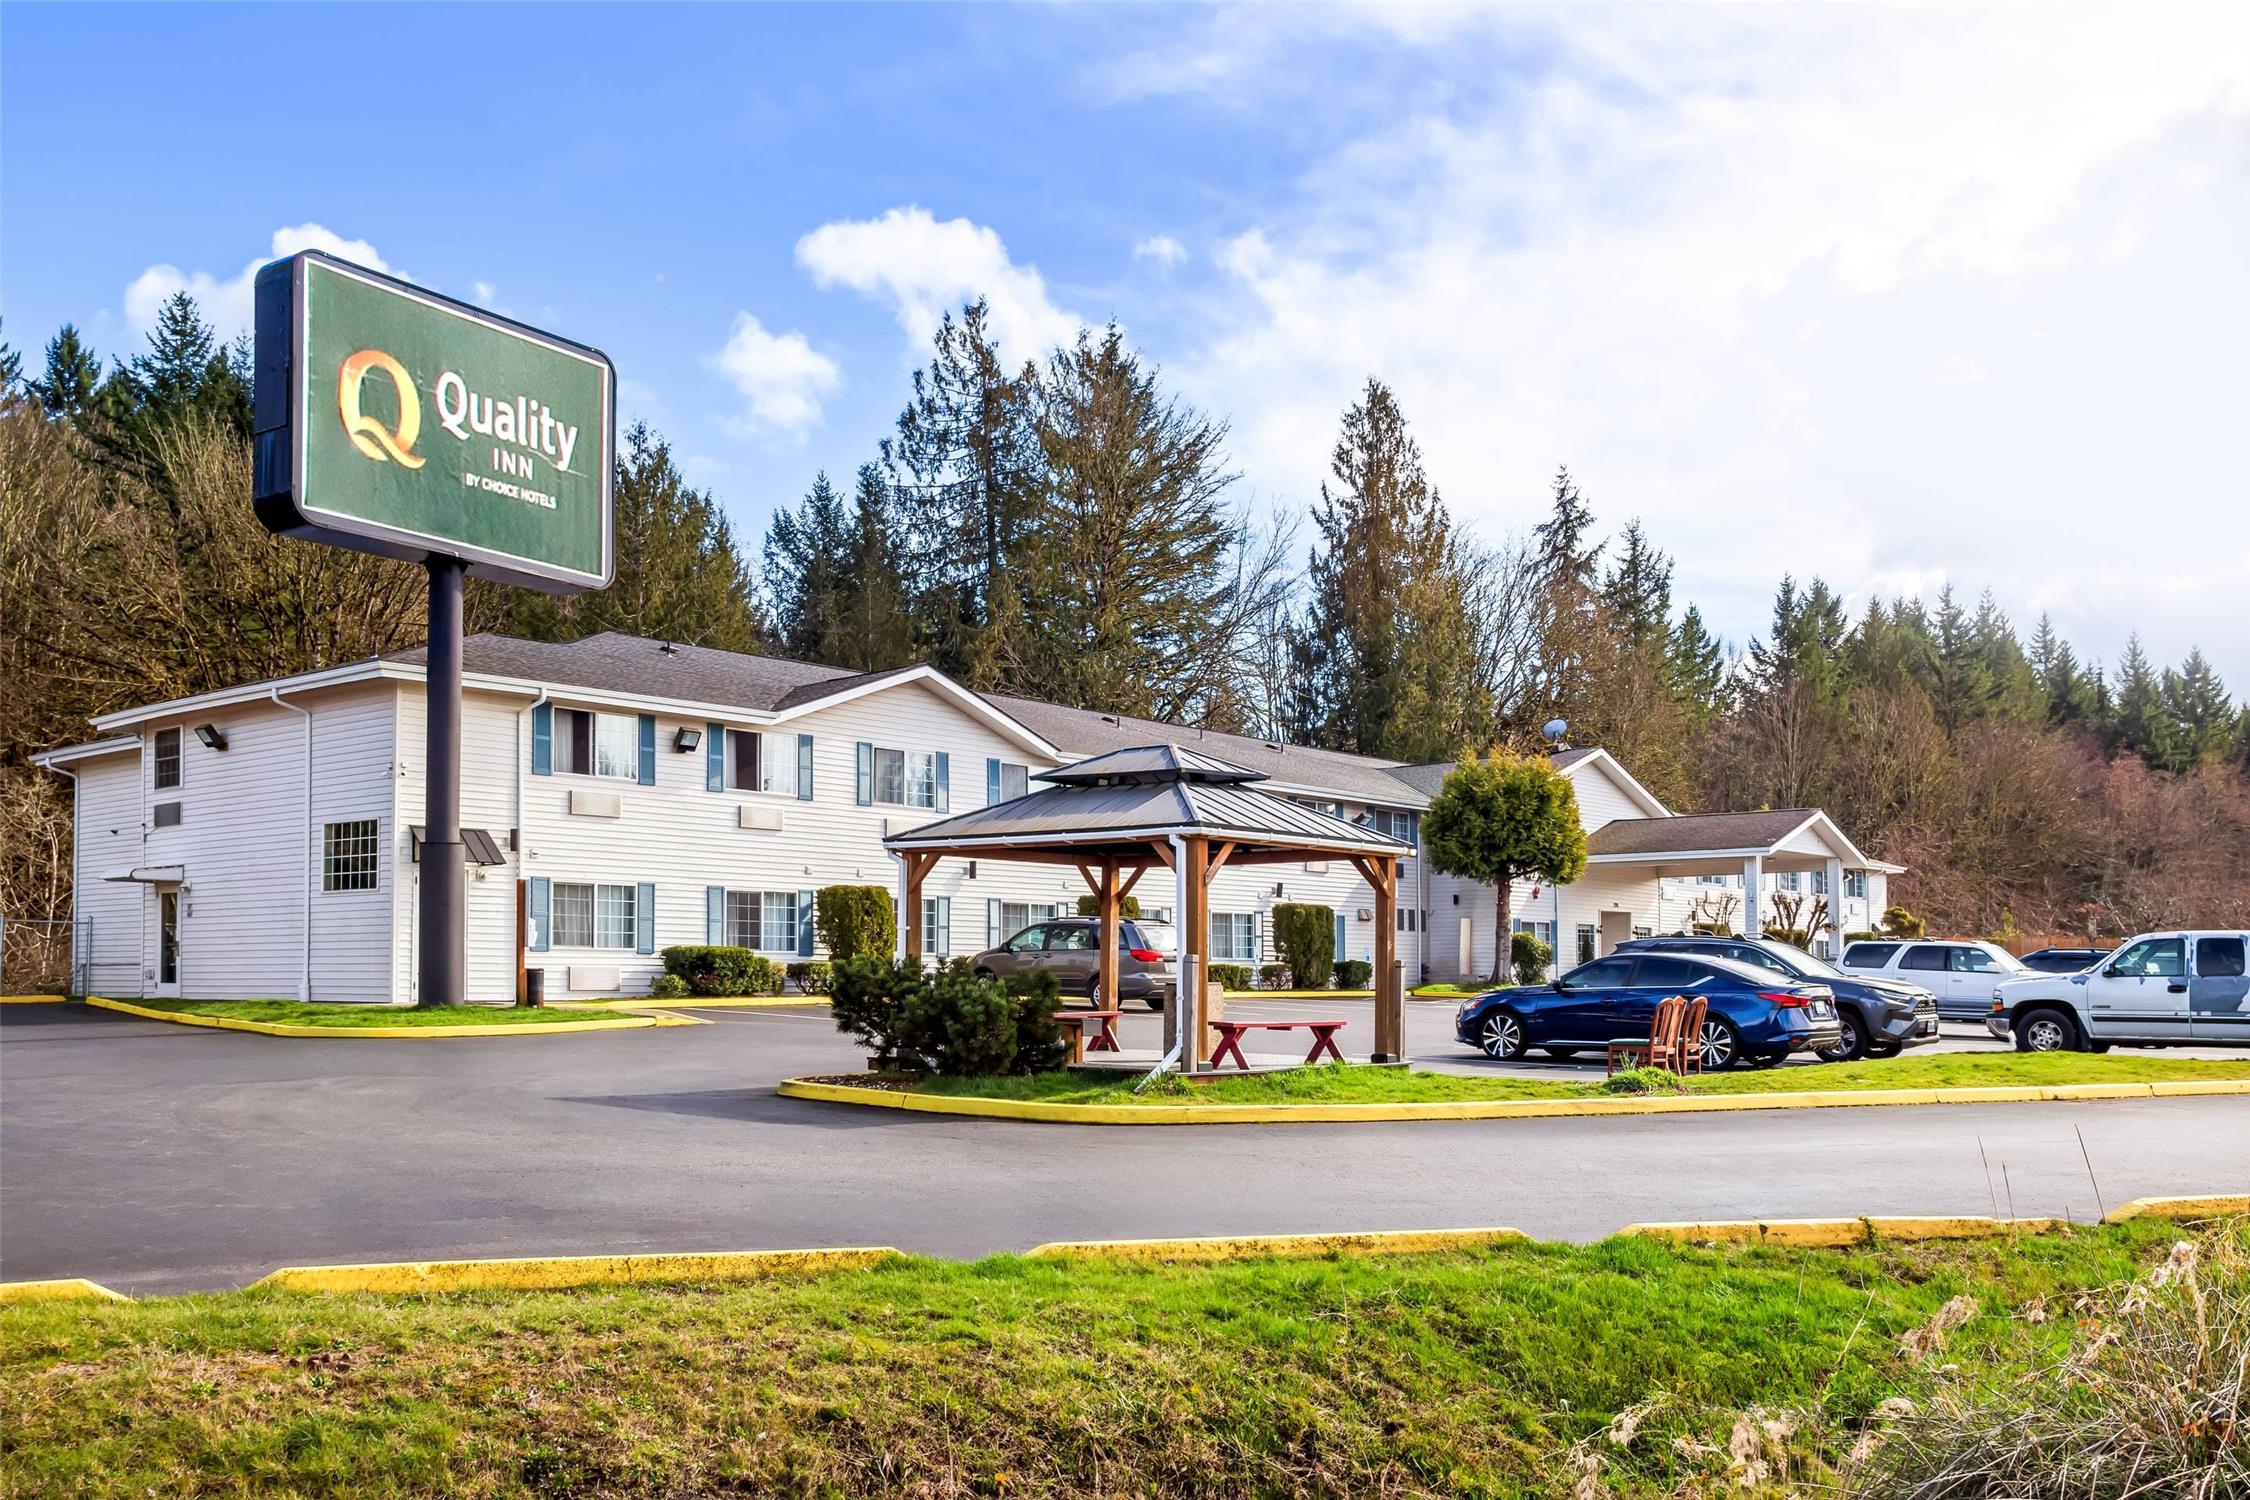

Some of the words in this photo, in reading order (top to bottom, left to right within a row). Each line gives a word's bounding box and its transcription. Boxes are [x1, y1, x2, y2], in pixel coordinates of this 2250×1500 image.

[338, 349, 426, 470] Q
[436, 371, 578, 472] Quality
[465, 472, 480, 487] BY
[481, 477, 520, 499] CHOICE
[520, 487, 557, 510] HOTELS
[493, 447, 534, 481] INN
